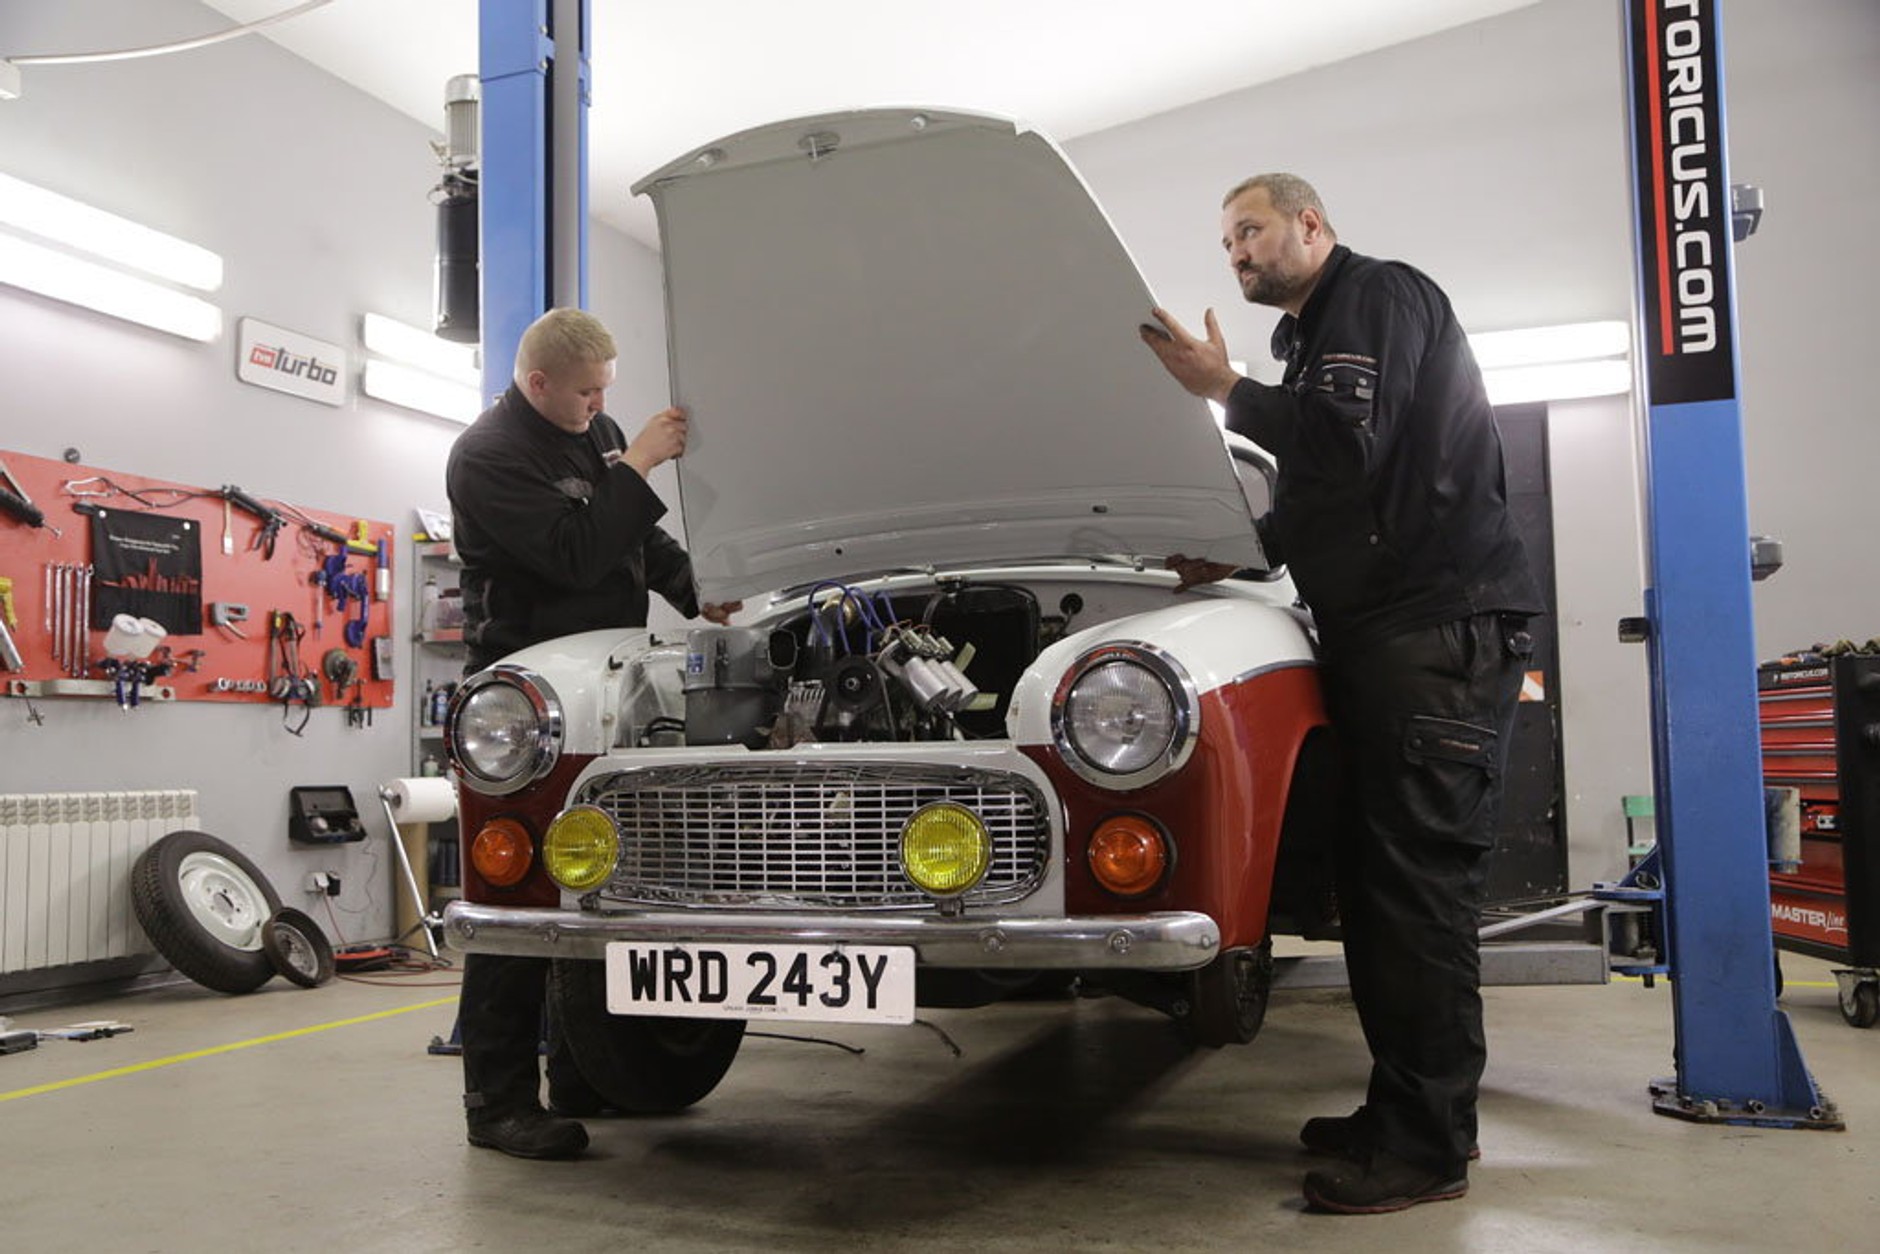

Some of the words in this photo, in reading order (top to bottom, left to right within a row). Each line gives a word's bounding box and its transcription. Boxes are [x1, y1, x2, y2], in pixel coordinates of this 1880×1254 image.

[275, 347, 337, 386] turbo
[1771, 903, 1826, 928] MASTER
[628, 949, 729, 1004] WRD
[746, 950, 888, 1009] 243Y
